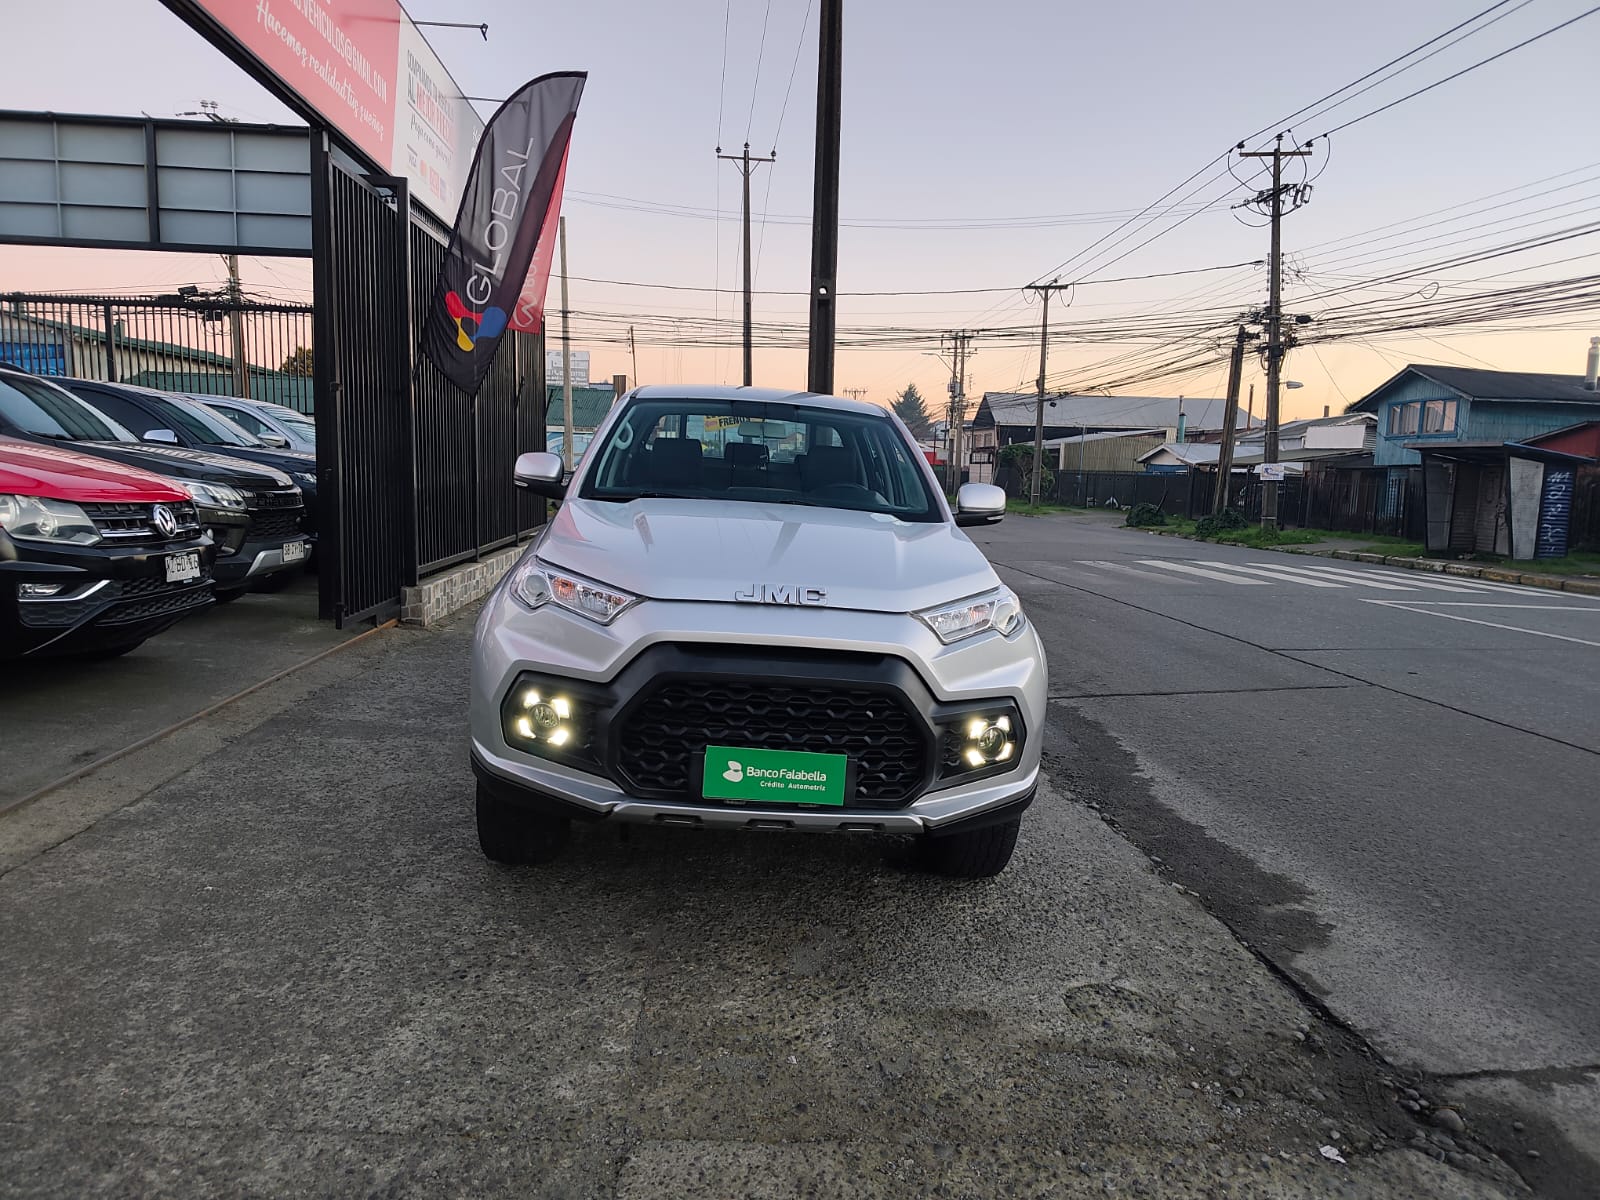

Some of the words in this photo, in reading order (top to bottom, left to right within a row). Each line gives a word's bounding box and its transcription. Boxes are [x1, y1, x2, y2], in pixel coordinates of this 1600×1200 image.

[256, 0, 308, 68] Hacemos
[466, 137, 534, 305] GLOBAL
[734, 583, 828, 606] JMC
[760, 780, 785, 789] Crédito
